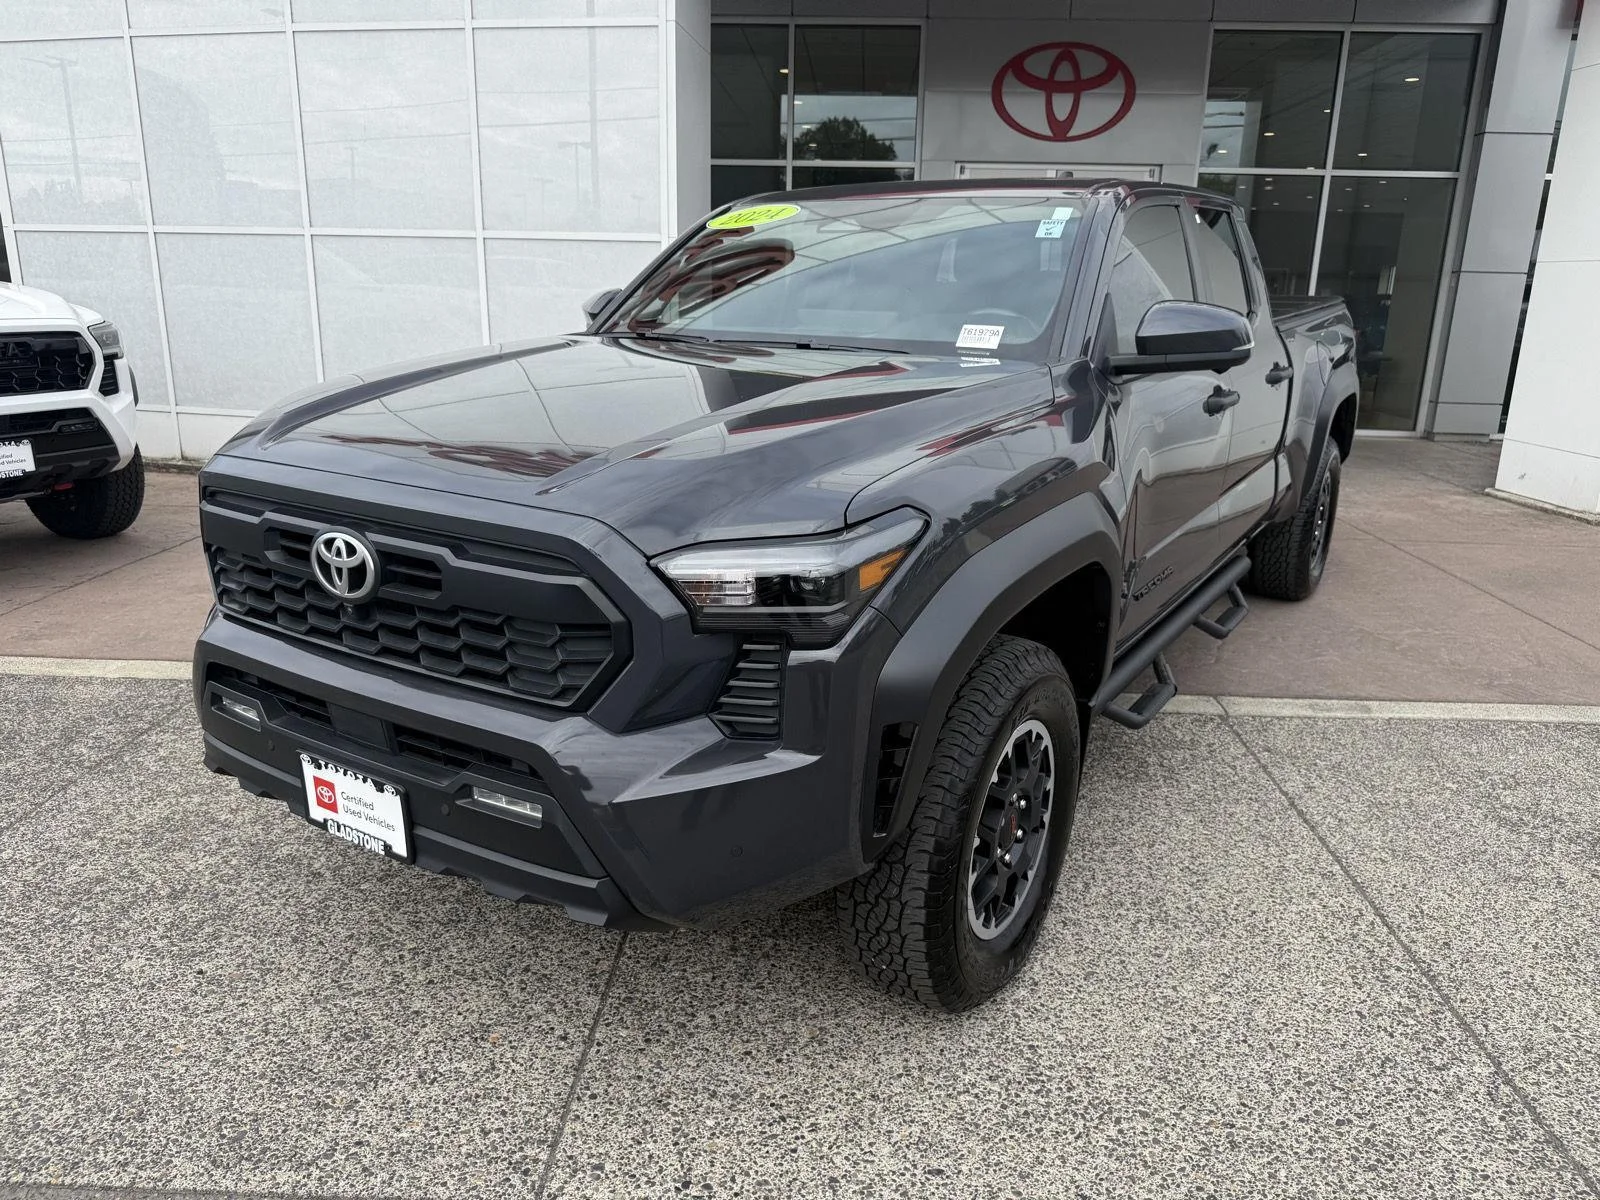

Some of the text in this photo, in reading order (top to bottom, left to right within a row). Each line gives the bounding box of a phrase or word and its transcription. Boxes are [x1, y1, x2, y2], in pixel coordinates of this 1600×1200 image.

[963, 327, 1000, 337] T61979A
[319, 759, 379, 792] TOYOTA
[340, 791, 374, 811] Certified
[342, 803, 396, 832] Used Vehicles
[327, 819, 386, 856] GLADSTONE
